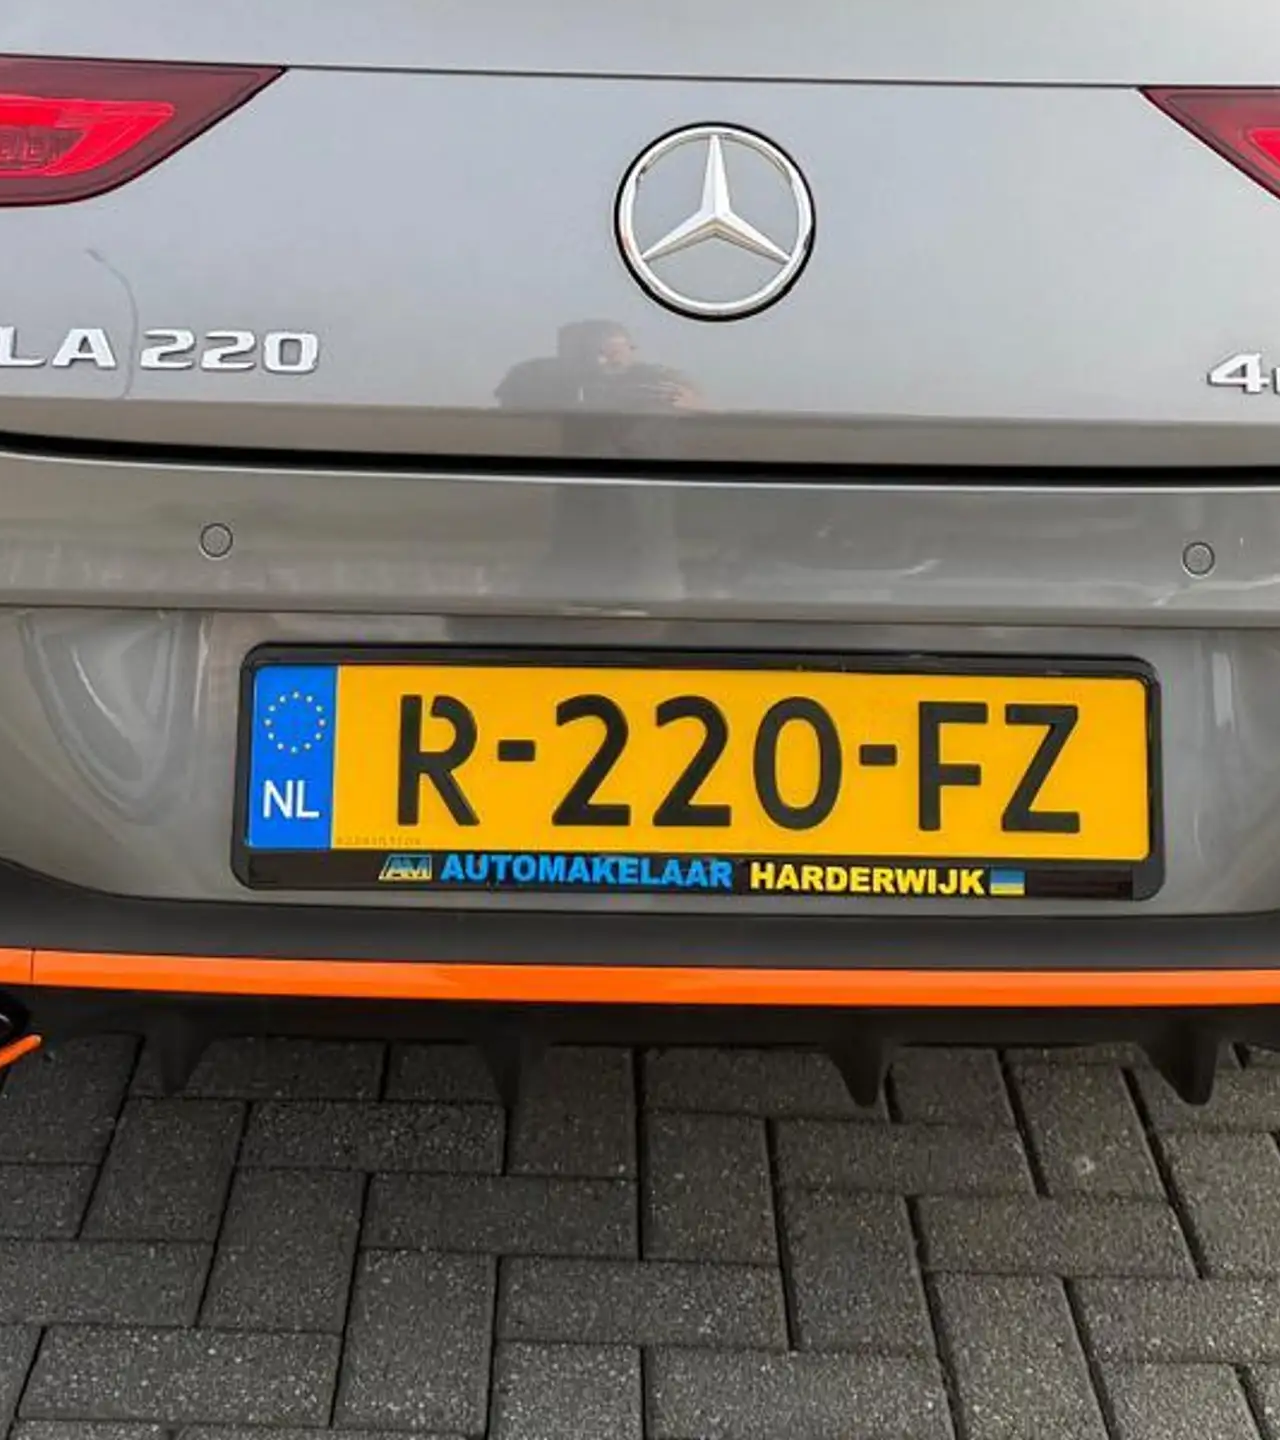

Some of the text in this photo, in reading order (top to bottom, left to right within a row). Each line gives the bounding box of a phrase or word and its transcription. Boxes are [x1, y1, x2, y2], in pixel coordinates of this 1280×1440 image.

[139, 328, 320, 374] 220
[396, 693, 1082, 835] R-220-FZ
[261, 778, 321, 820] NL
[439, 856, 734, 891] AUTOMAKELAAR
[749, 861, 985, 897] HARDERWIJK
